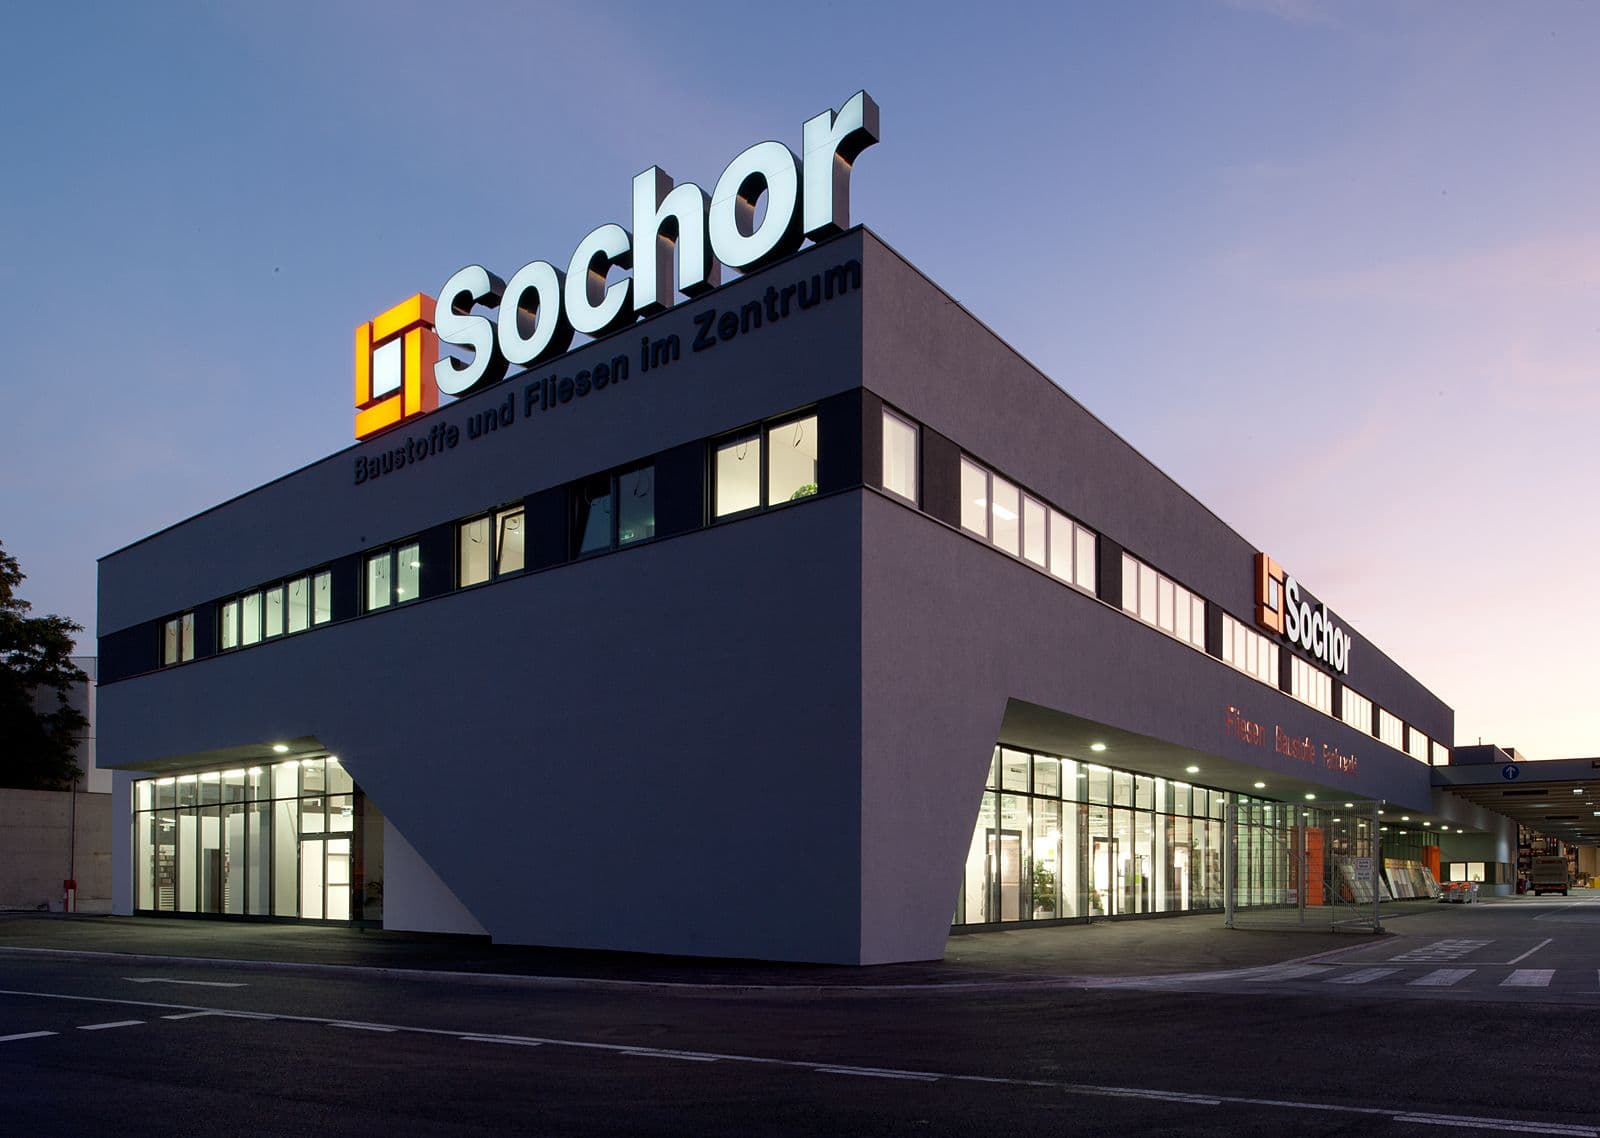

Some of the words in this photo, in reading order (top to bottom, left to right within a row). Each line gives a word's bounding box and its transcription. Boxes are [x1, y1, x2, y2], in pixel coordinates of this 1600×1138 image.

[433, 90, 878, 397] Sochor
[354, 424, 459, 485] Baustoffe
[468, 395, 515, 440] und
[524, 351, 629, 417] Fliesen
[640, 333, 680, 372] im
[692, 258, 862, 353] Zentrum
[1285, 575, 1351, 675] Sochor
